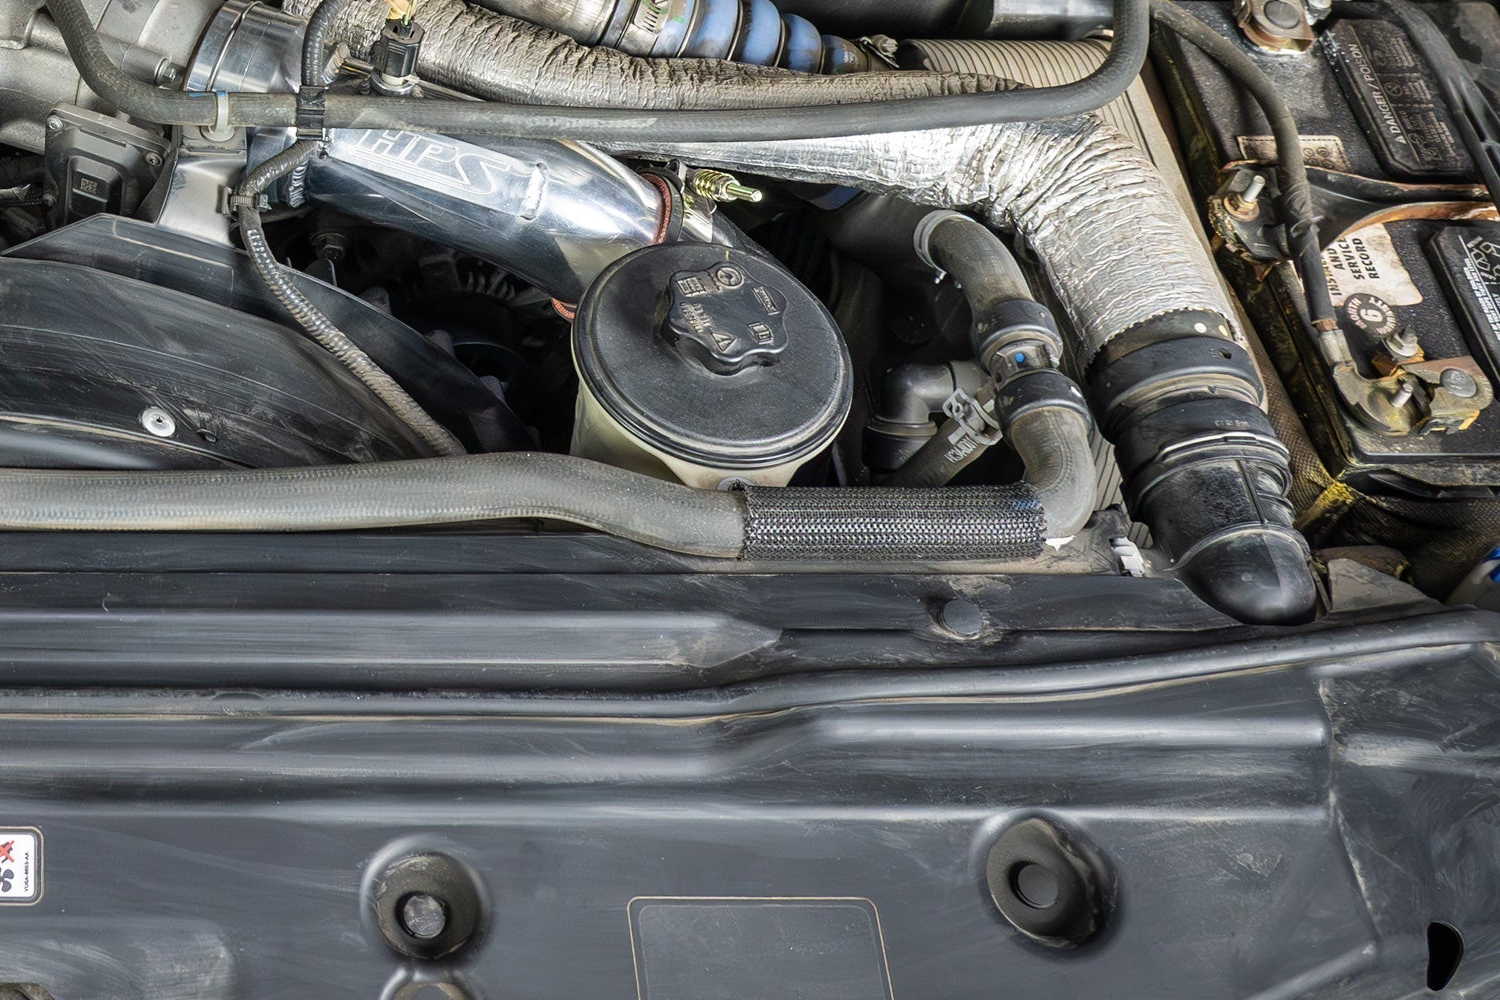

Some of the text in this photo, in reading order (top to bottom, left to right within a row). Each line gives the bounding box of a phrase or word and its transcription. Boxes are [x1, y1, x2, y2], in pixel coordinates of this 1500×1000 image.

[1348, 43, 1376, 82] POISON
[1373, 92, 1403, 134] DANGER
[352, 128, 512, 195] HPS
[1328, 248, 1346, 270] AND
[1338, 238, 1365, 280] SERVICE
[1352, 238, 1380, 280] RECORD
[1346, 298, 1367, 330] MONTH
[1360, 309, 1384, 322] 6
